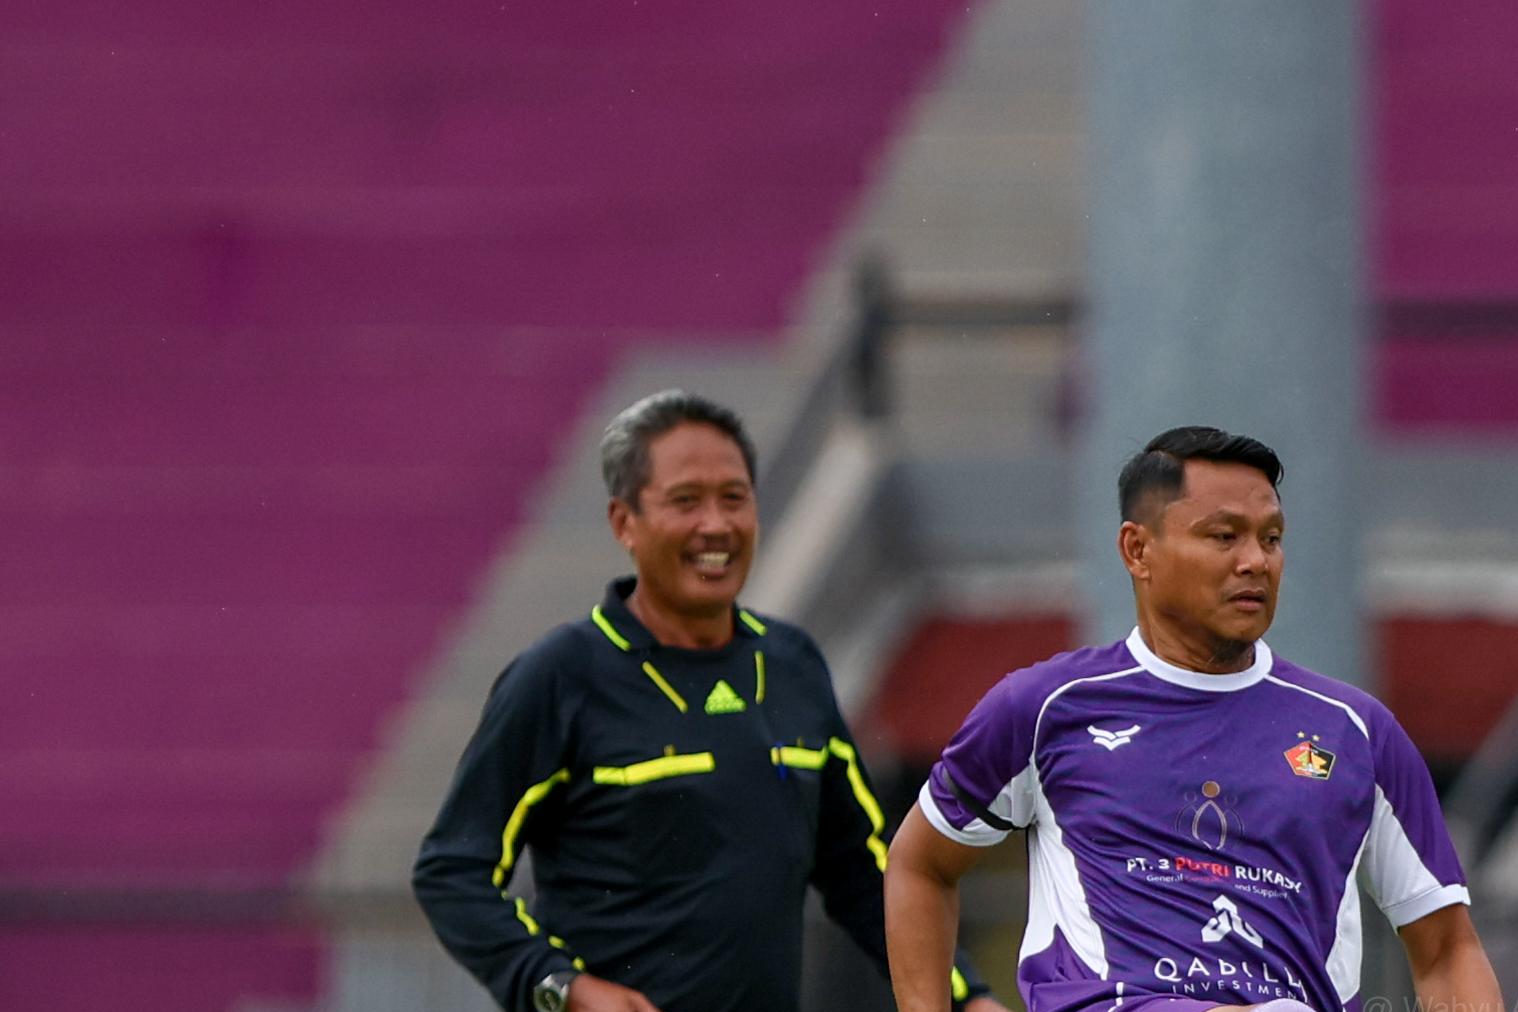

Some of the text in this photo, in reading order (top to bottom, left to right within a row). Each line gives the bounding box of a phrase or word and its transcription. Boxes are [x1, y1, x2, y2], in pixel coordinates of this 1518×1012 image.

[1126, 857, 1154, 873] PT.
[1158, 858, 1170, 872] 3
[1175, 856, 1230, 877] PUTRI
[1172, 979, 1297, 1000] INVESTMEN
